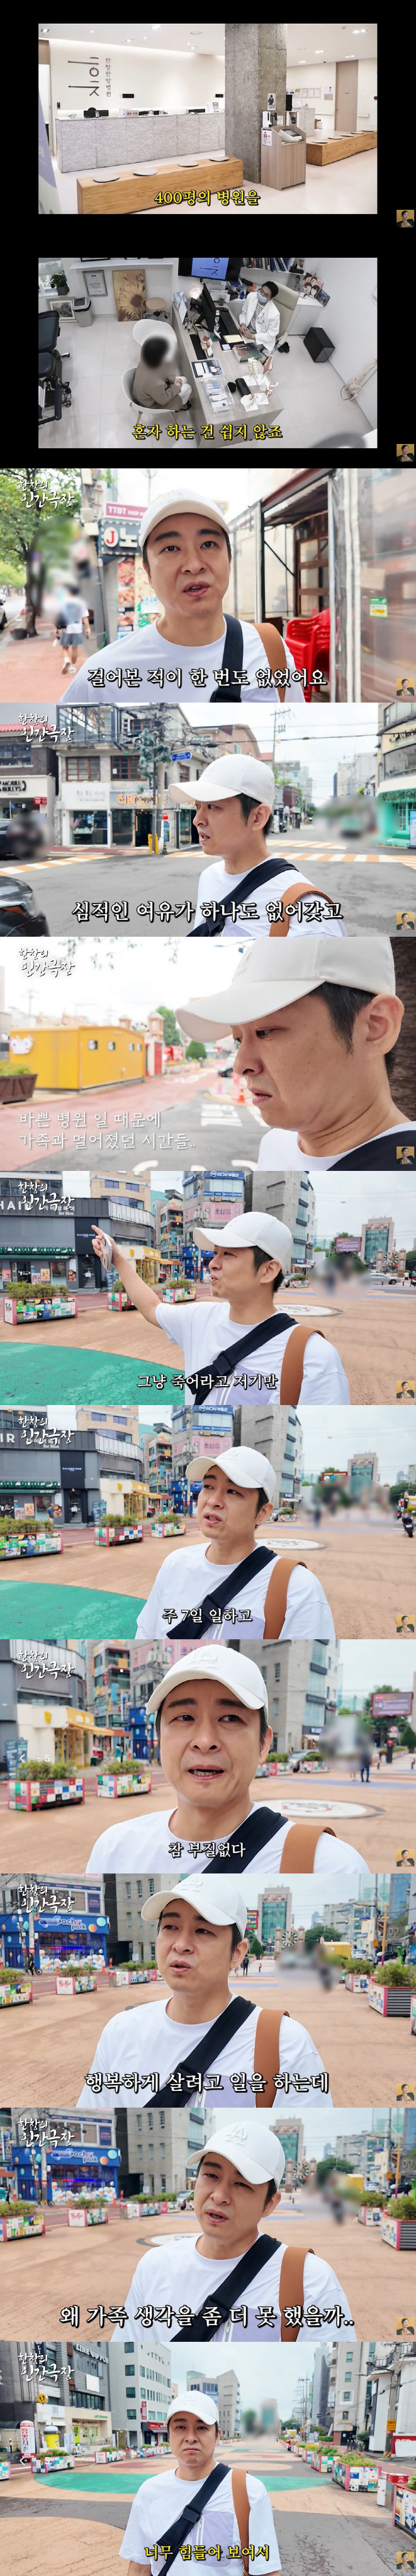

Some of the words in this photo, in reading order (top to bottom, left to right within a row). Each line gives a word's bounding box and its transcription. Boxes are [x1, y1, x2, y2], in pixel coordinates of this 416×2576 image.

[106, 531, 115, 544] J
[75, 2343, 90, 2355] LINE
[99, 2354, 109, 2364] PUB
